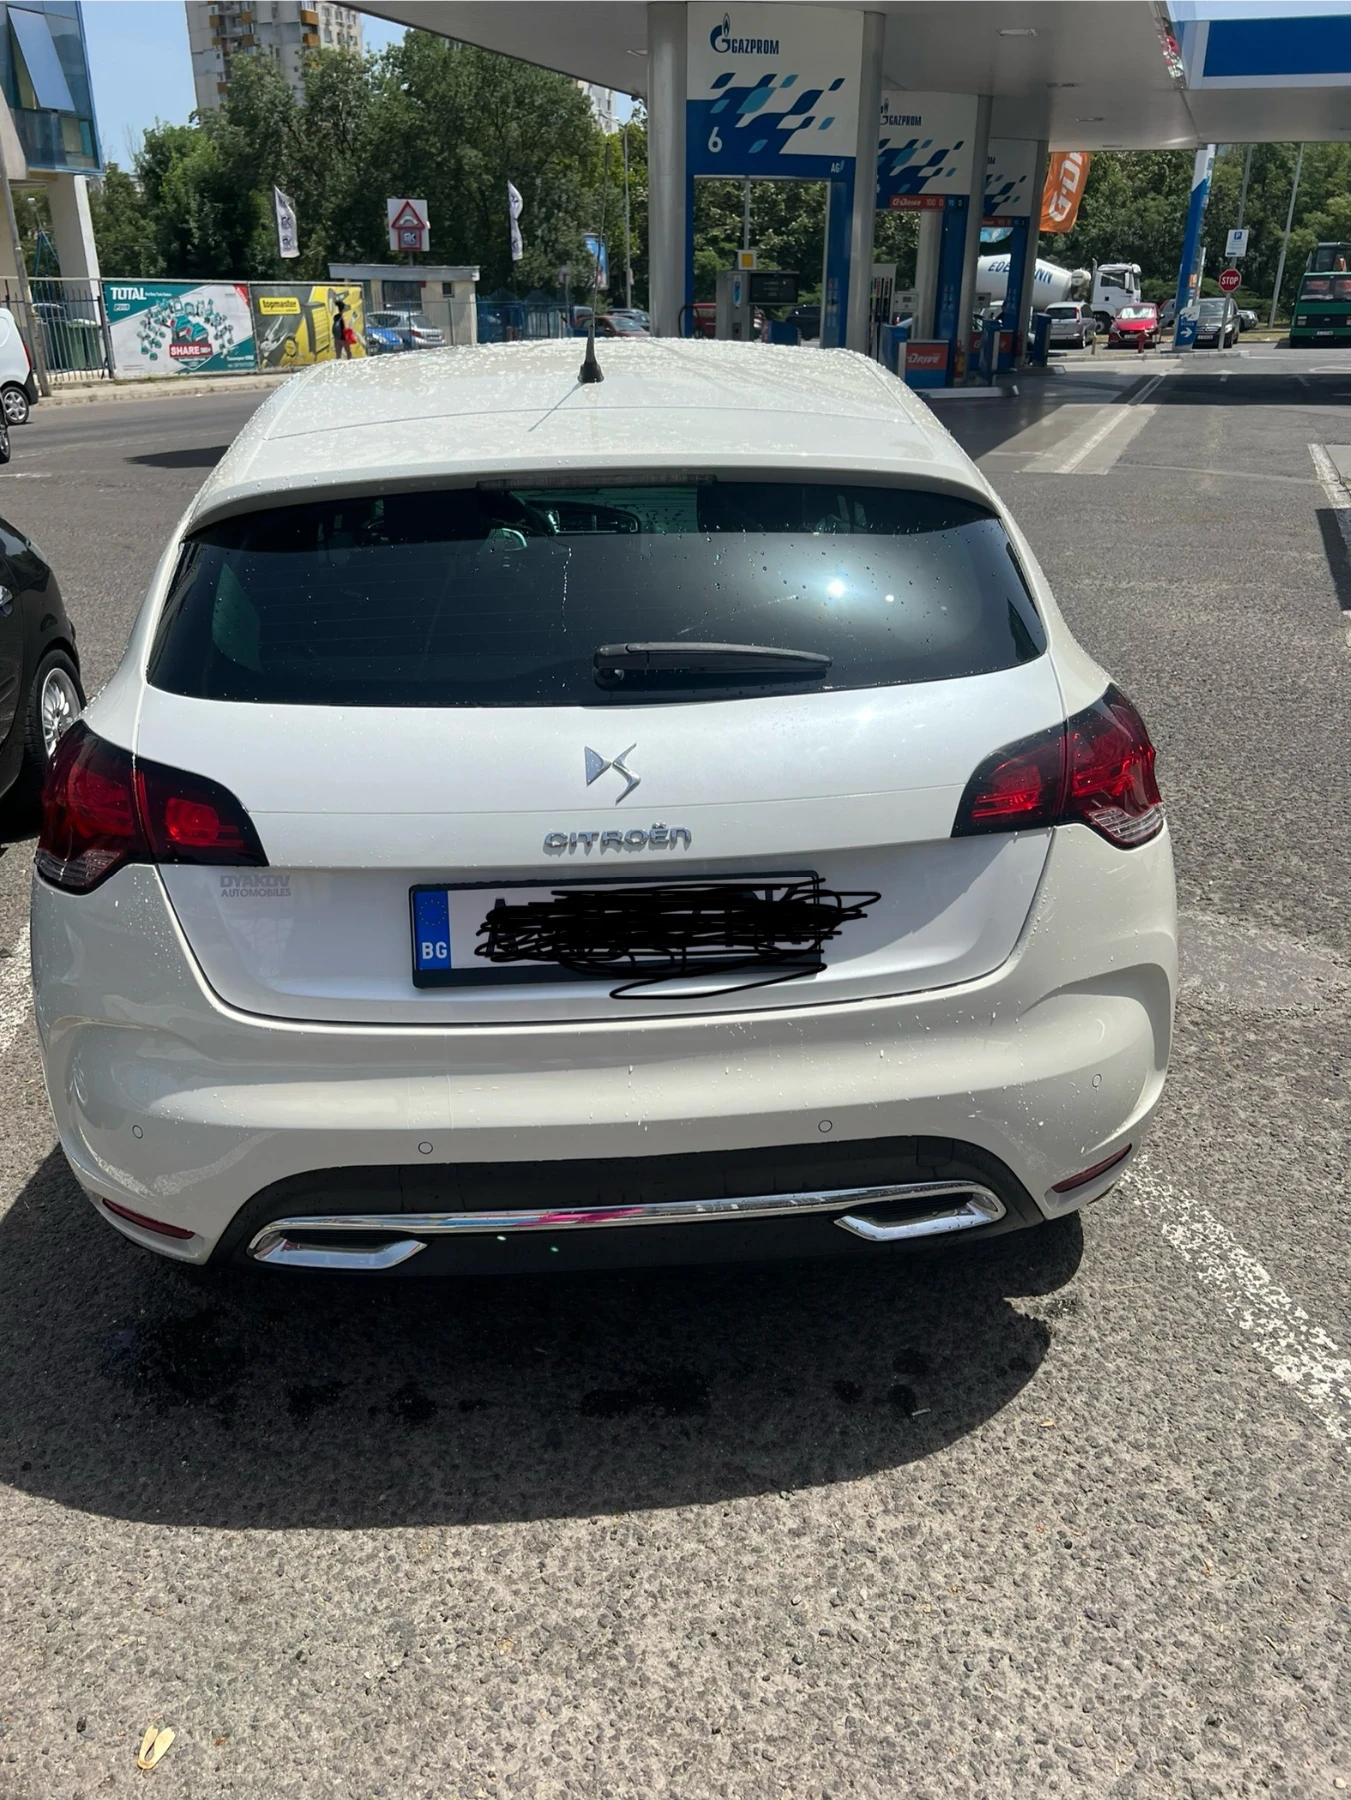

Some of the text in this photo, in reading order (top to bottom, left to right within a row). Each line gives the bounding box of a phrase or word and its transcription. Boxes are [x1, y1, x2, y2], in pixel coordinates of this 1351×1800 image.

[731, 38, 780, 55] GAZPROM
[888, 115, 922, 127] GAZPROM
[707, 126, 723, 153] 6
[1221, 276, 1239, 285] STOP
[110, 287, 147, 300] TOTAL
[262, 300, 297, 309] topmaster
[170, 346, 201, 356] SHARE
[220, 875, 291, 888] DYAKOV
[221, 888, 291, 897] AUTOMOBILES
[422, 942, 448, 959] BG
